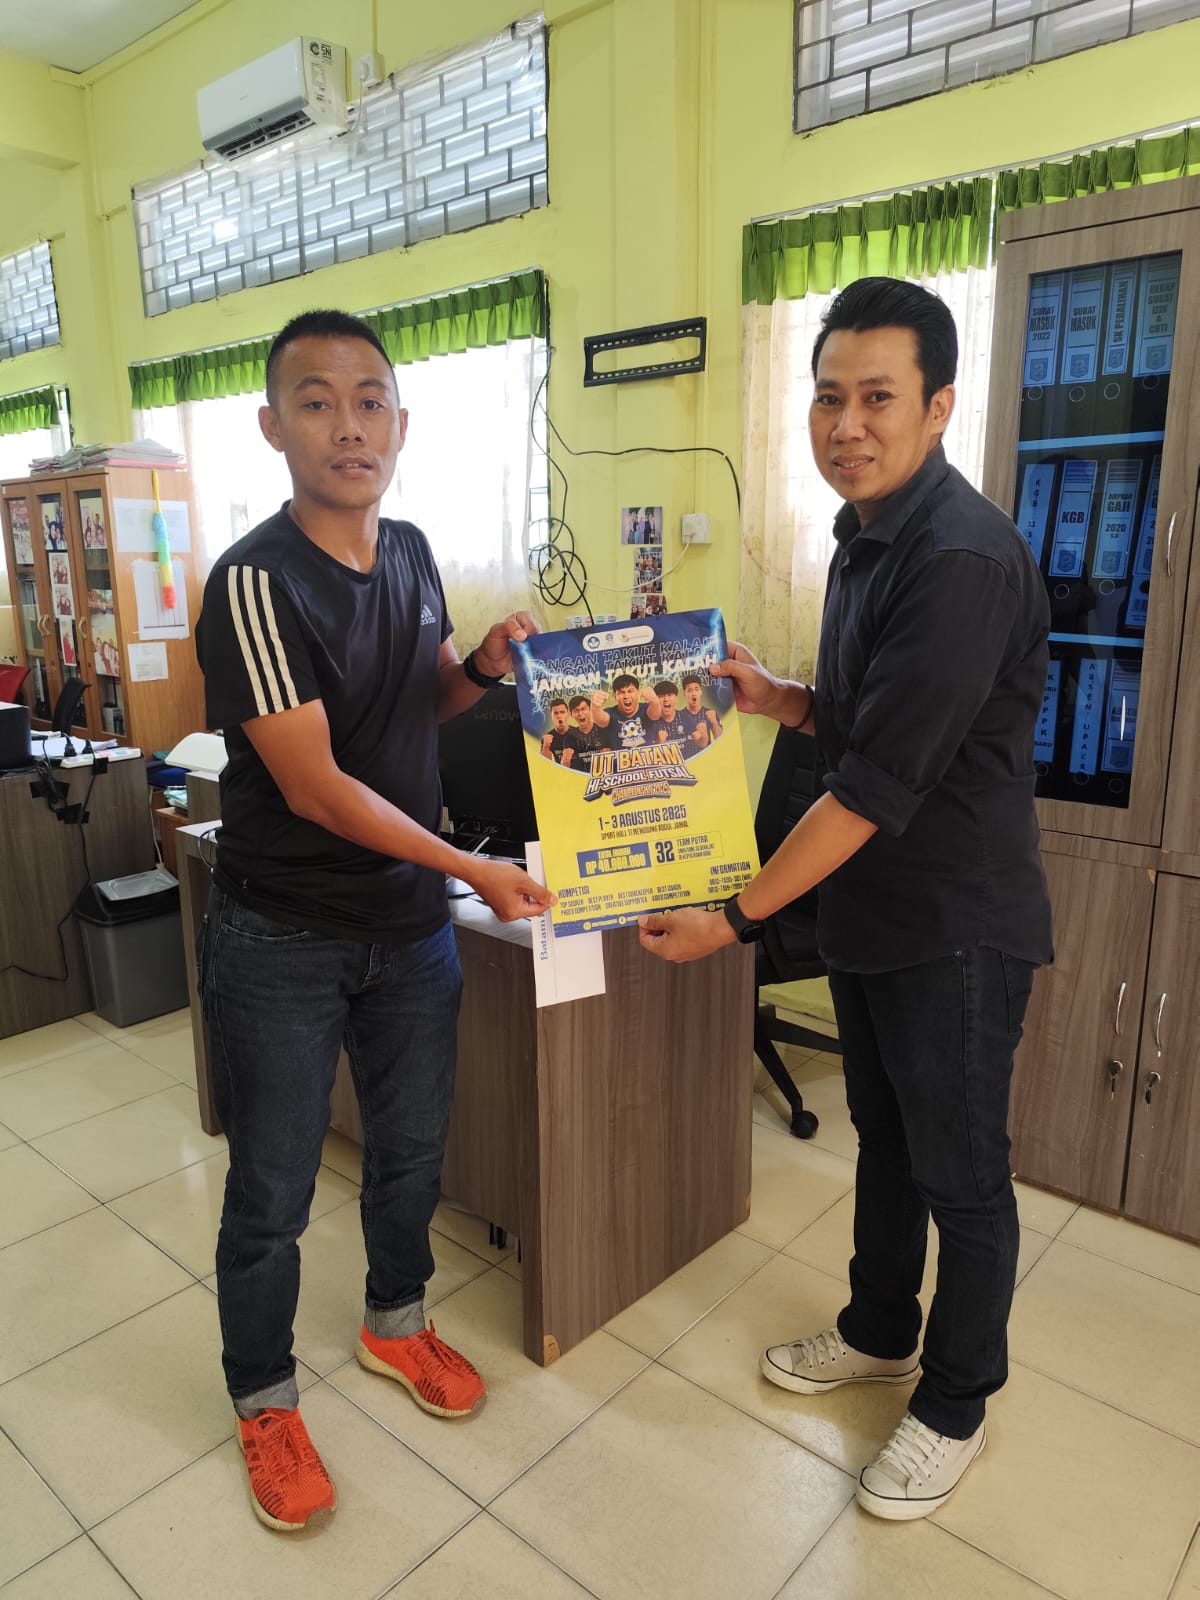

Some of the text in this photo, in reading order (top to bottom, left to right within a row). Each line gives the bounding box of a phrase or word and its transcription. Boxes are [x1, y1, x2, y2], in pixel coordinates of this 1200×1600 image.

[321, 45, 332, 57] SNI
[1032, 306, 1055, 316] SURAT
[1073, 306, 1096, 316] SURAT
[1030, 316, 1056, 332] MASUK
[1071, 315, 1096, 332] MASUK
[1032, 332, 1051, 341] 2022
[1107, 501, 1131, 512] GAJI
[1061, 511, 1085, 524] KGB
[1105, 523, 1127, 533] 2020
[603, 644, 655, 662] TAKUT
[530, 671, 600, 694] JANGAN
[663, 653, 717, 675] KALAH
[592, 753, 615, 778] UT
[619, 743, 682, 769] BATAM
[586, 765, 695, 795] HI-SCHOOL FUTSAL
[598, 817, 604, 830] 1
[612, 815, 618, 828] 3
[620, 808, 660, 827] AGUSTUS
[663, 804, 687, 822] 2025
[655, 840, 675, 863] 32
[710, 861, 751, 875] INFORMATION
[540, 919, 548, 960] Batam
